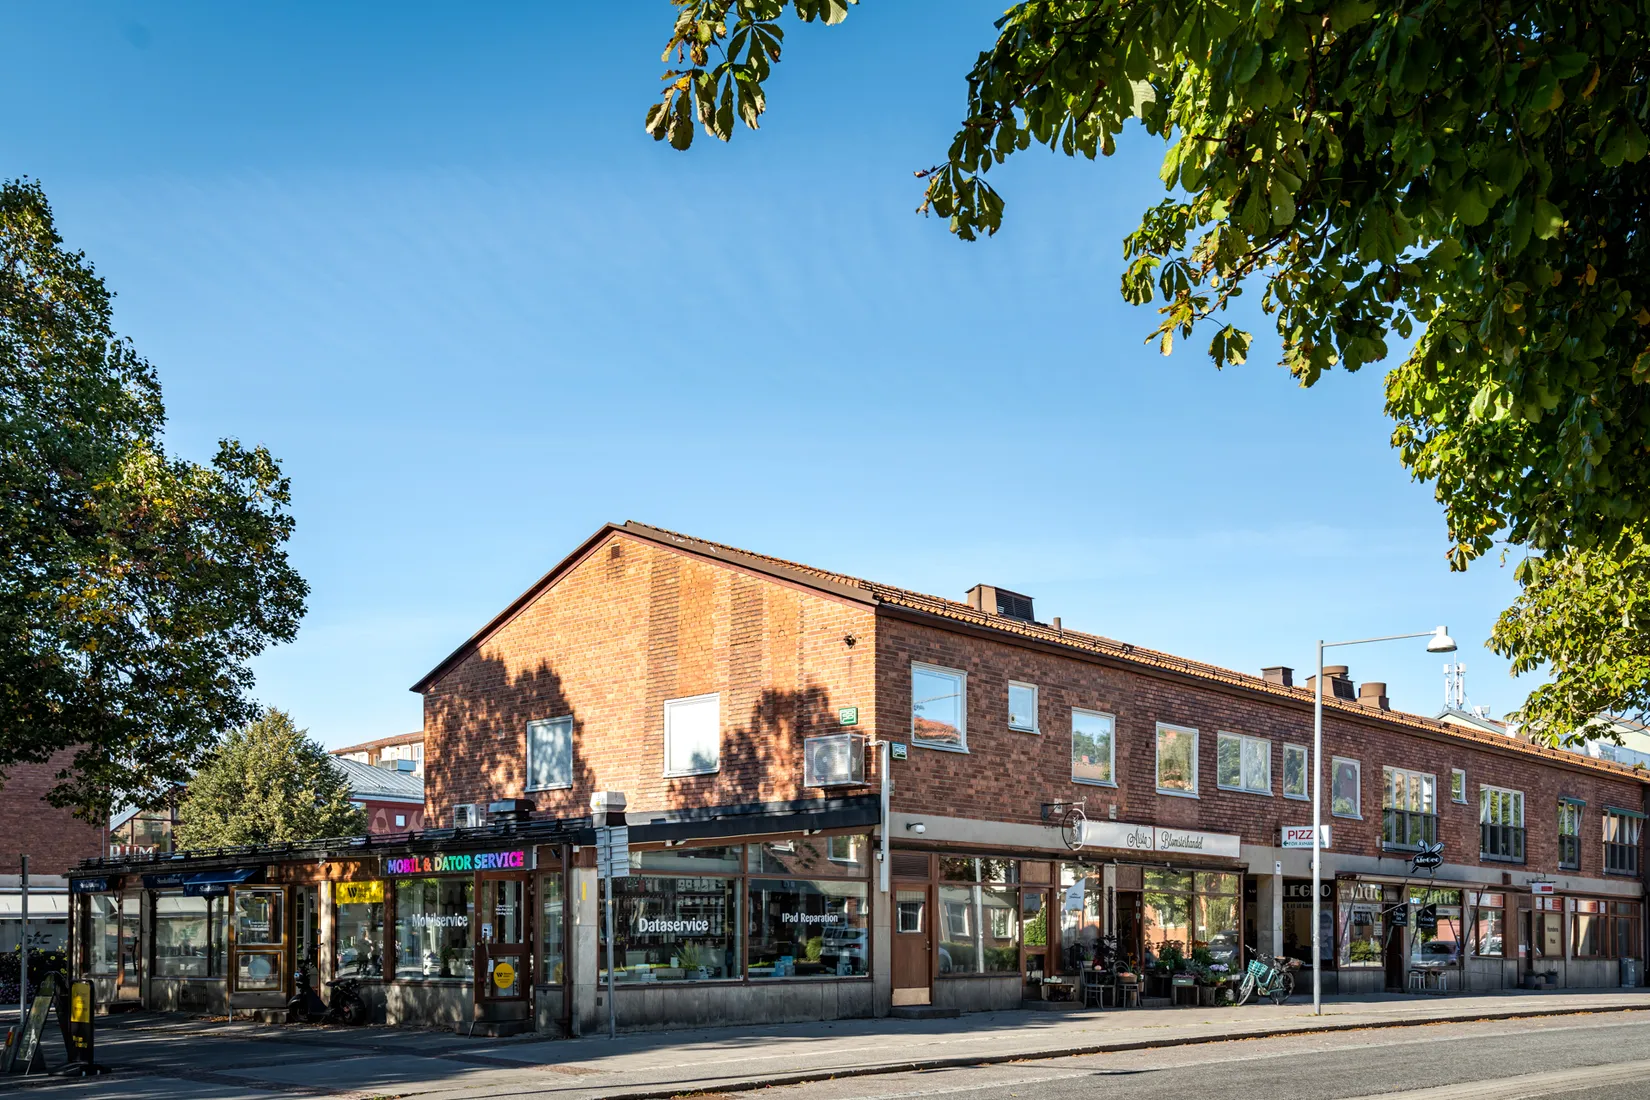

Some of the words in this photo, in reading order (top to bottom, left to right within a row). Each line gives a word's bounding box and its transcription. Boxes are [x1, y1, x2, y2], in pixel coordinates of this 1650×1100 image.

[1287, 829, 1322, 841] PIZZ
[387, 857, 422, 874] MOBIL
[423, 856, 432, 872] &
[433, 854, 473, 872] DATOR
[473, 850, 525, 870] SERVICE
[411, 912, 469, 928] Mobilservice
[638, 916, 709, 933] Dataservice
[781, 911, 799, 923] IPad
[800, 912, 839, 926] Reparation
